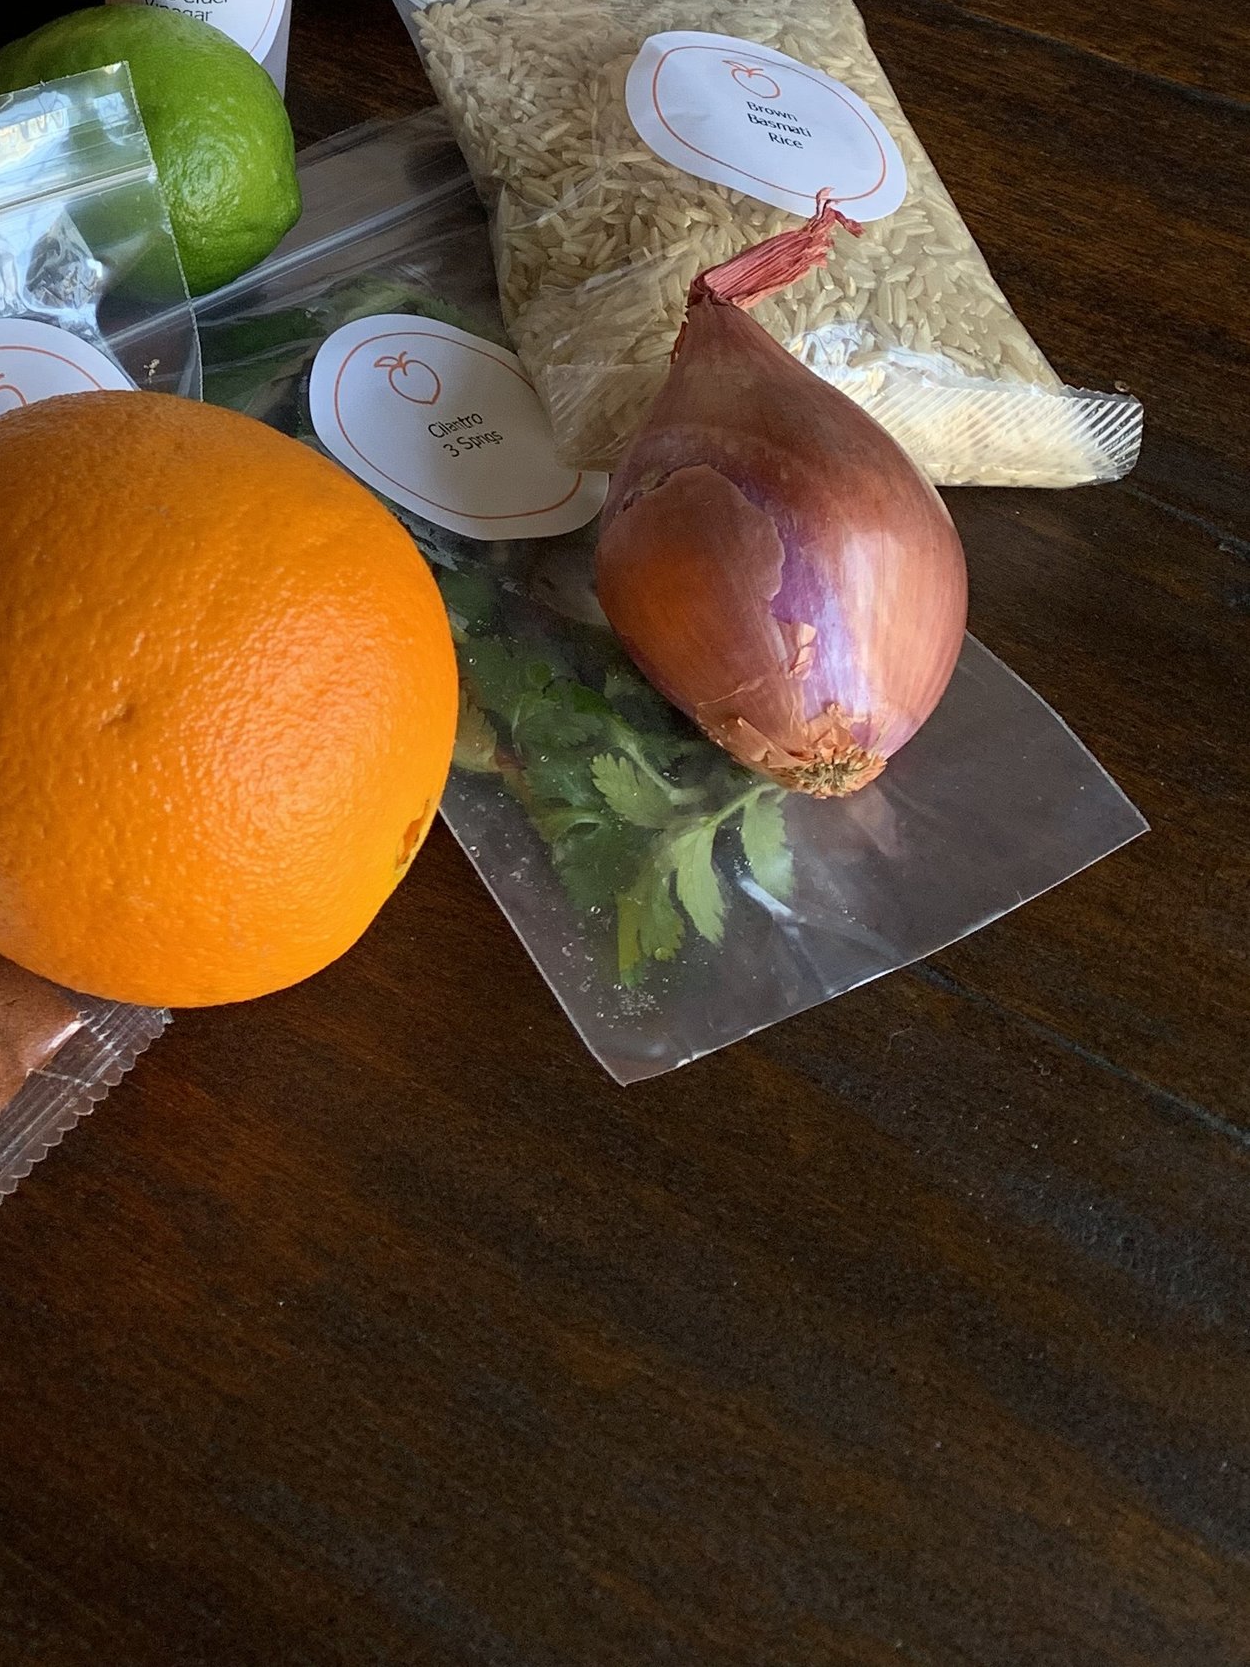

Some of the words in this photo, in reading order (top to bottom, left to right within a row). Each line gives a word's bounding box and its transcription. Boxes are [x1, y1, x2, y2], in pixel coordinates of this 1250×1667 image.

[747, 101, 798, 122] Brown
[748, 114, 812, 138] Basmati
[769, 131, 805, 150] Rice
[428, 413, 483, 439] Cilantro
[443, 443, 460, 458] 3
[456, 431, 503, 450] Sprigs
